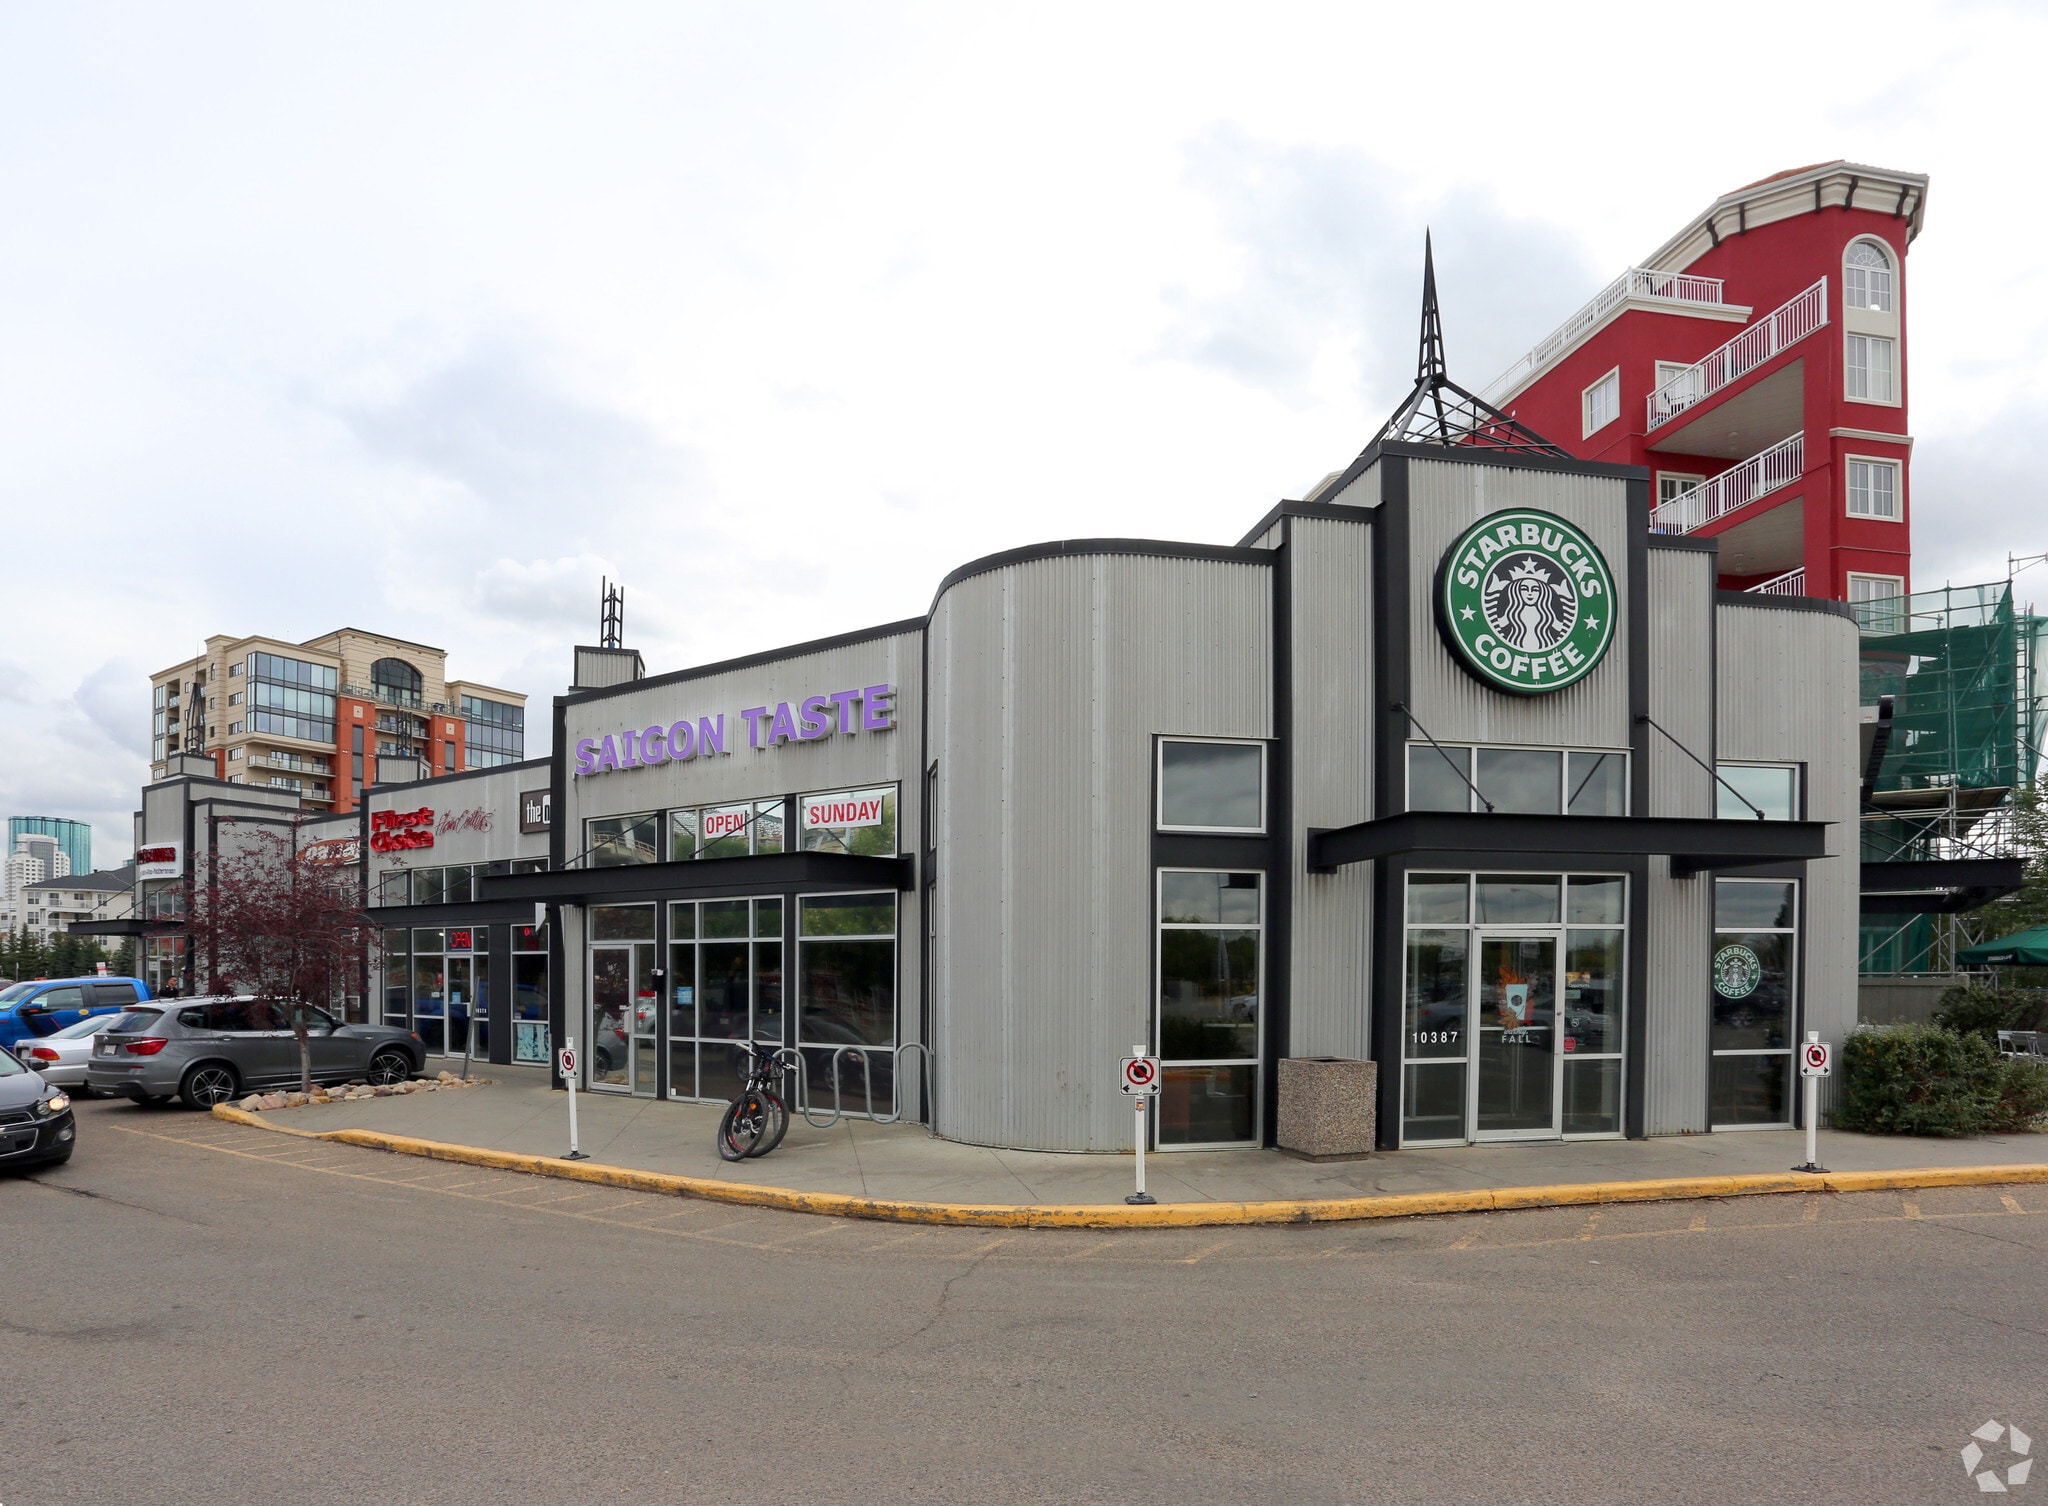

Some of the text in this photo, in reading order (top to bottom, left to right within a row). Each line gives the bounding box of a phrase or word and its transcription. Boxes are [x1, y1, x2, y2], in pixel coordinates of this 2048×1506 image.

[1457, 523, 1602, 598] STARBUCKS
[1474, 633, 1586, 680] COFFEE
[575, 683, 897, 776] SAIGON TASTE
[371, 807, 435, 831] First
[526, 799, 541, 824] the
[810, 800, 880, 825] SUNDAY
[705, 813, 744, 835] OPEN
[1714, 947, 1758, 970] STARBUCKS
[1718, 982, 1752, 996] COFFEE
[1412, 1031, 1458, 1044] 10387
[1501, 1034, 1532, 1044] FALL
